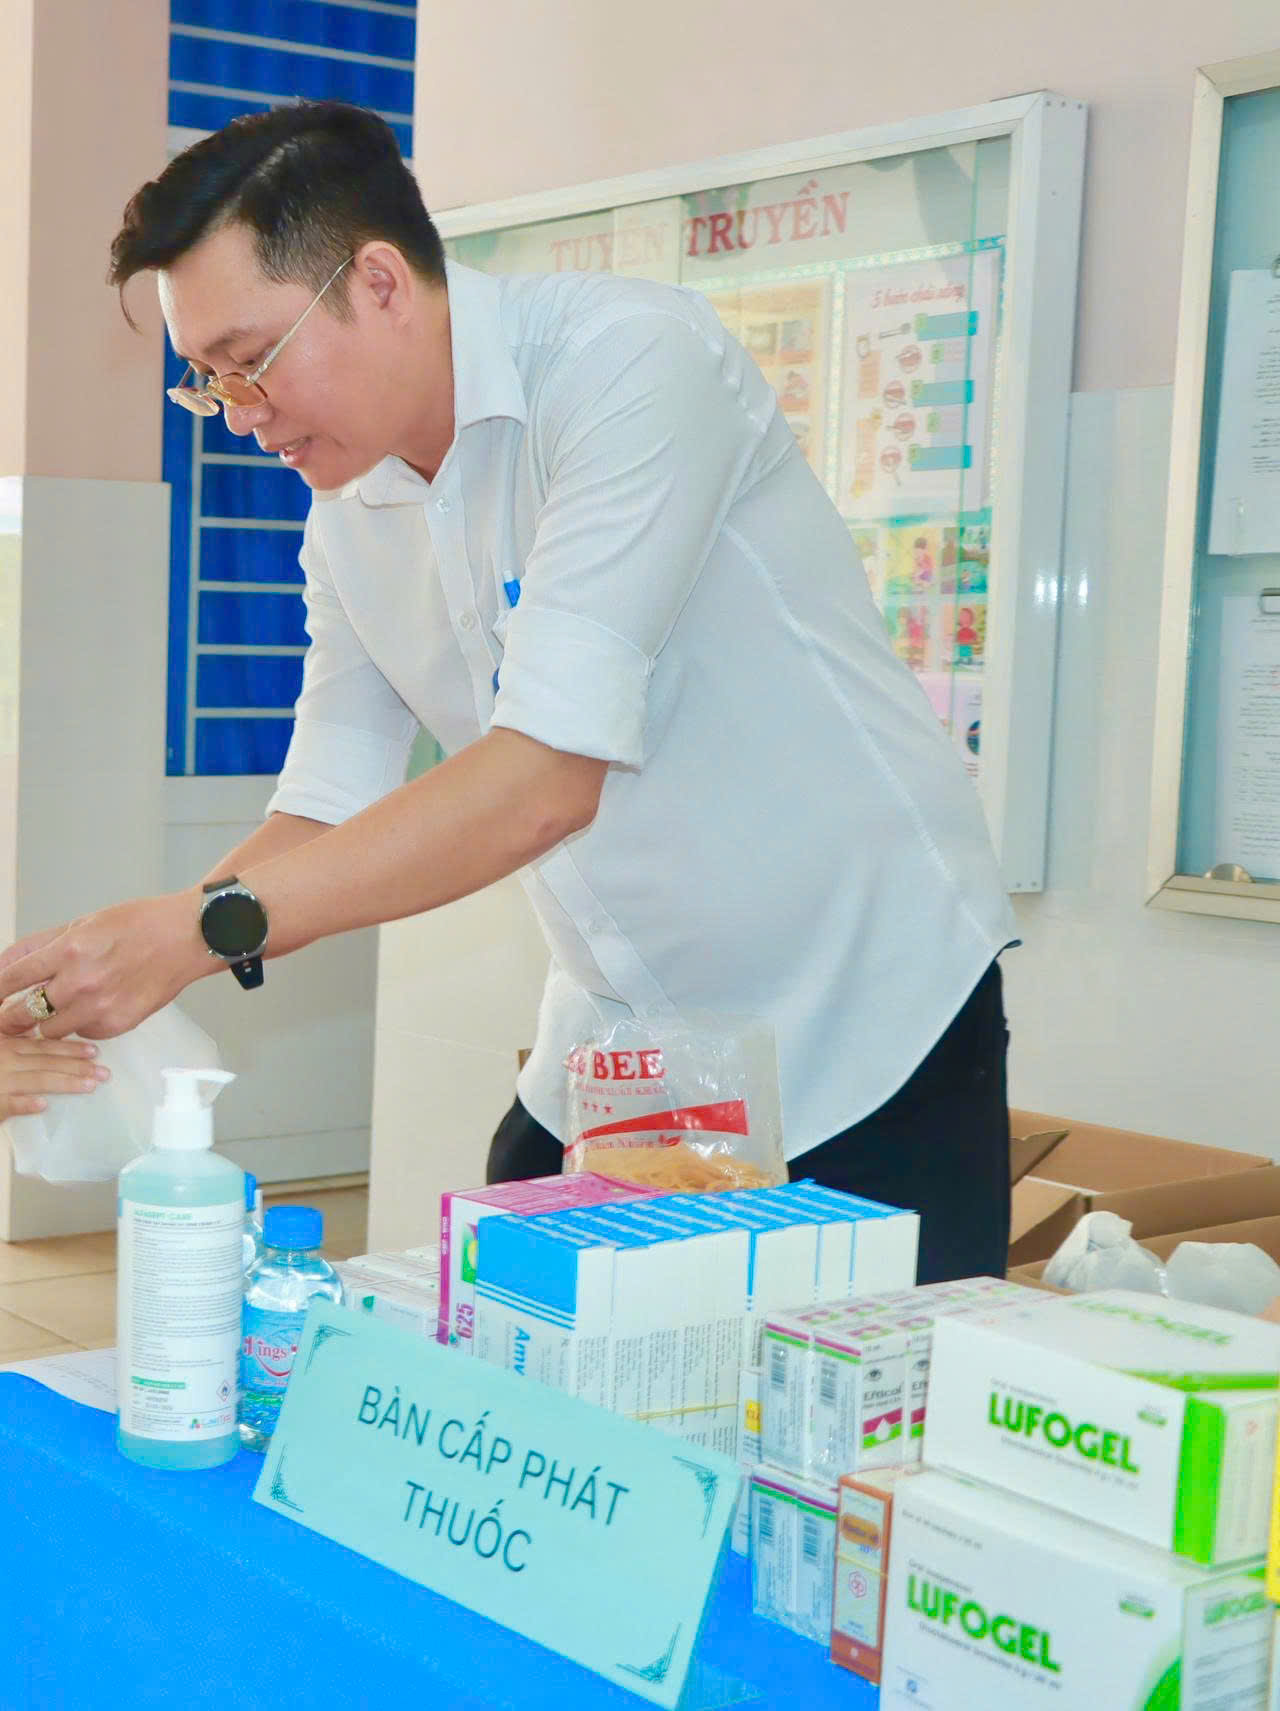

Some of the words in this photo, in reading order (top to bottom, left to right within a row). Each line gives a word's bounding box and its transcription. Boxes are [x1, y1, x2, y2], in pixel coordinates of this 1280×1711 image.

[593, 1049, 667, 1081] BEE
[455, 1302, 476, 1340] 625
[357, 1385, 431, 1447] BÀN
[438, 1410, 512, 1475] CẤP
[519, 1449, 630, 1526] PHÁT
[988, 1391, 1141, 1475] LUFOGEL
[403, 1479, 532, 1573] THUỐC
[907, 1574, 1062, 1675] LUFOGEL
